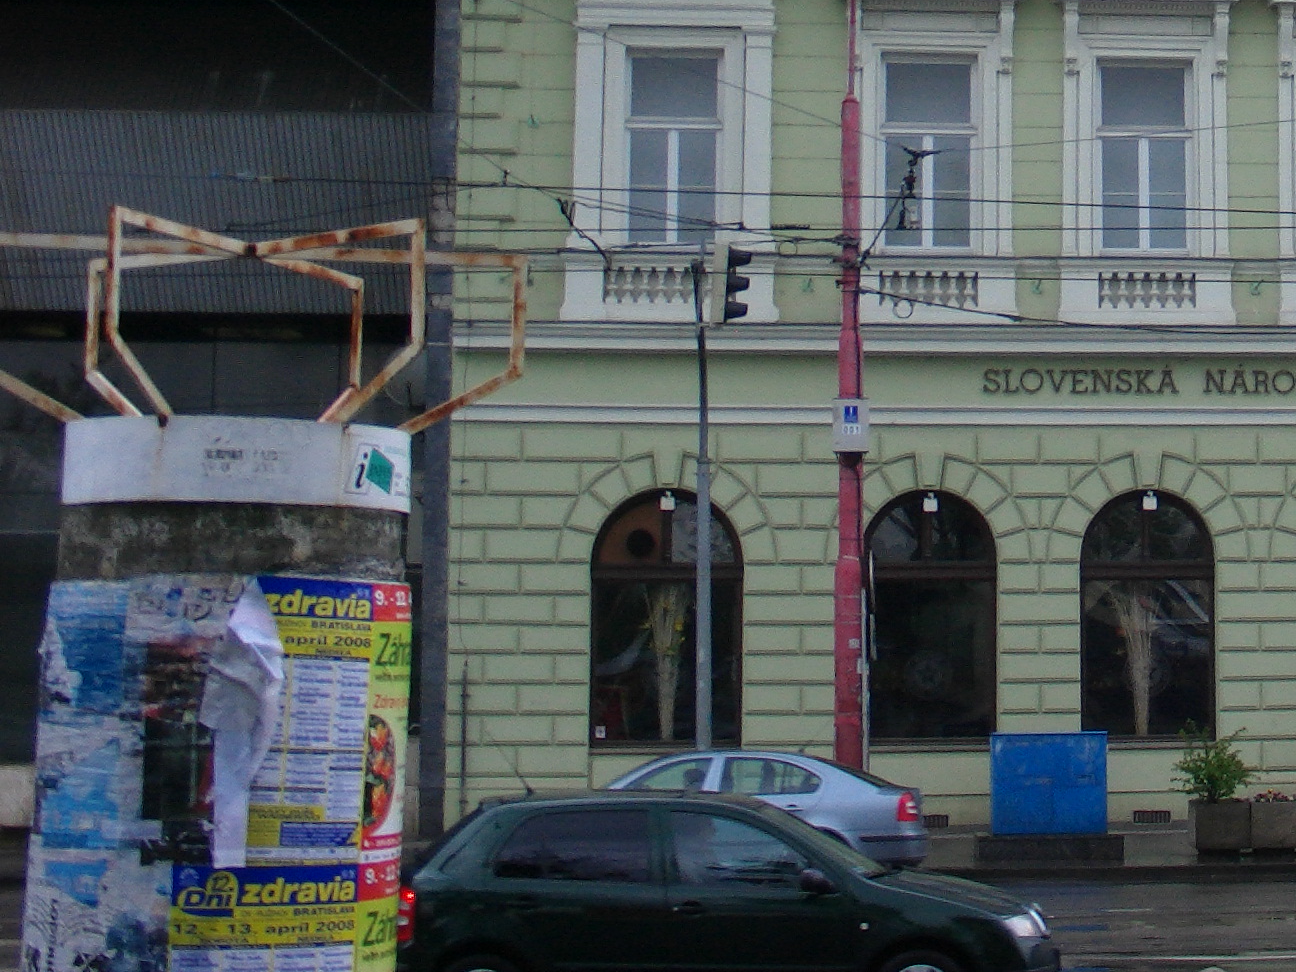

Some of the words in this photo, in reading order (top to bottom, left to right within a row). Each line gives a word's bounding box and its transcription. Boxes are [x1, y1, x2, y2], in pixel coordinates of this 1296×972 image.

[982, 364, 1180, 395] SLOVENSKÁ
[264, 588, 372, 620] zdravia
[333, 635, 372, 648] 2008
[241, 876, 356, 904] zdravia
[293, 906, 355, 917] BRATISLAVA
[315, 918, 356, 933] 2008
